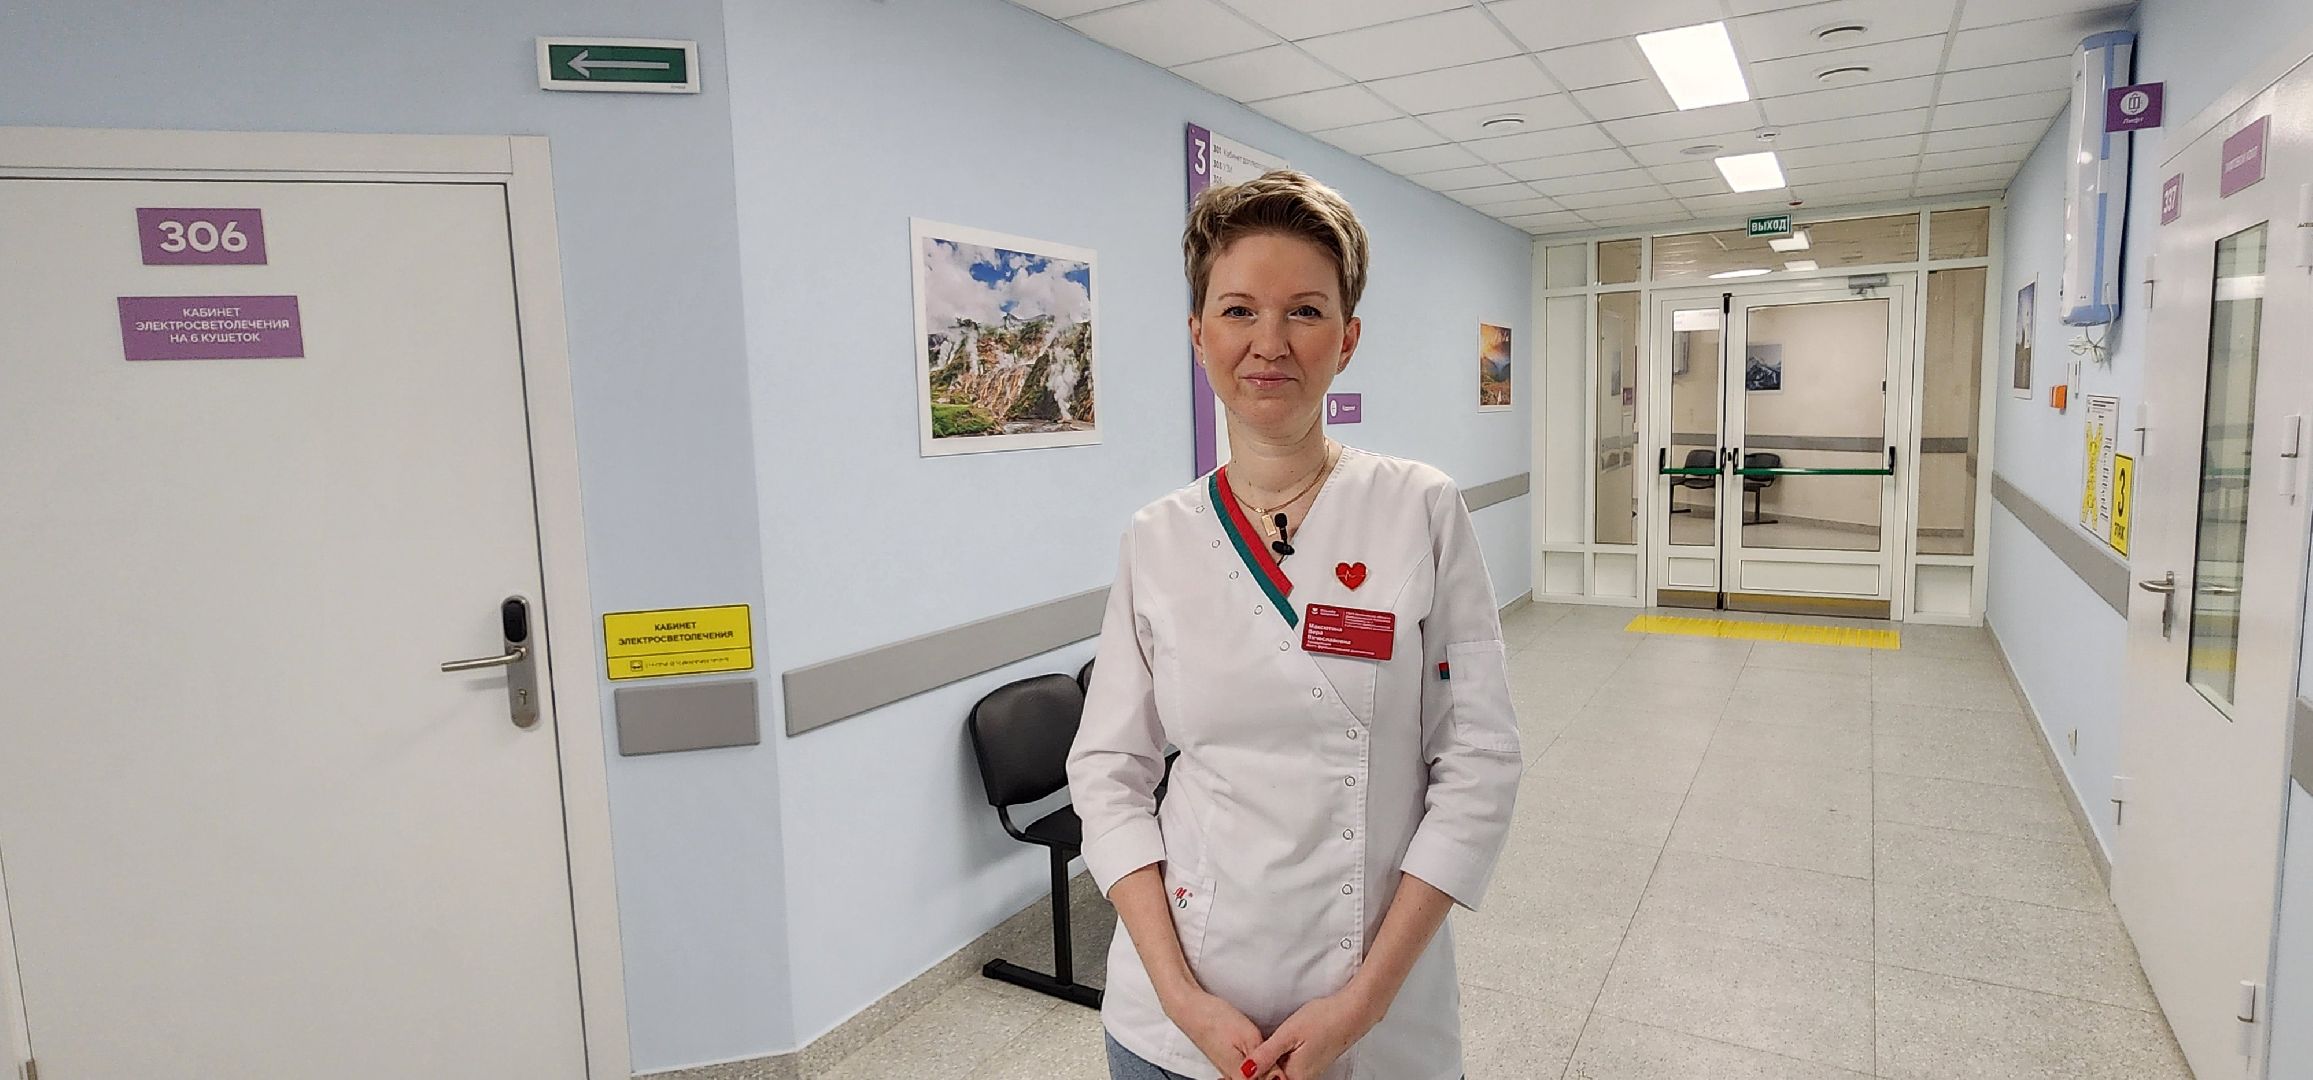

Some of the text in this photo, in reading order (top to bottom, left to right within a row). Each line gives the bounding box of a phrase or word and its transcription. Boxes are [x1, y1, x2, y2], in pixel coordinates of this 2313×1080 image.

[1194, 138, 1206, 174] 3
[1751, 219, 1786, 232] ВЫХОД
[158, 220, 248, 253] 306
[182, 307, 241, 317] КАБИНЕТ
[136, 319, 290, 331] ЭЛЕКТРОСВЕТОЛЕЧЕНИЯ
[170, 332, 260, 343] НА 6 КУШЕТОК
[2117, 467, 2125, 518] 3
[654, 621, 697, 631] КАБИНЕТ
[618, 630, 734, 646] ЭЛЕКТРОСВЕТОЛЕЧЕНИЯ
